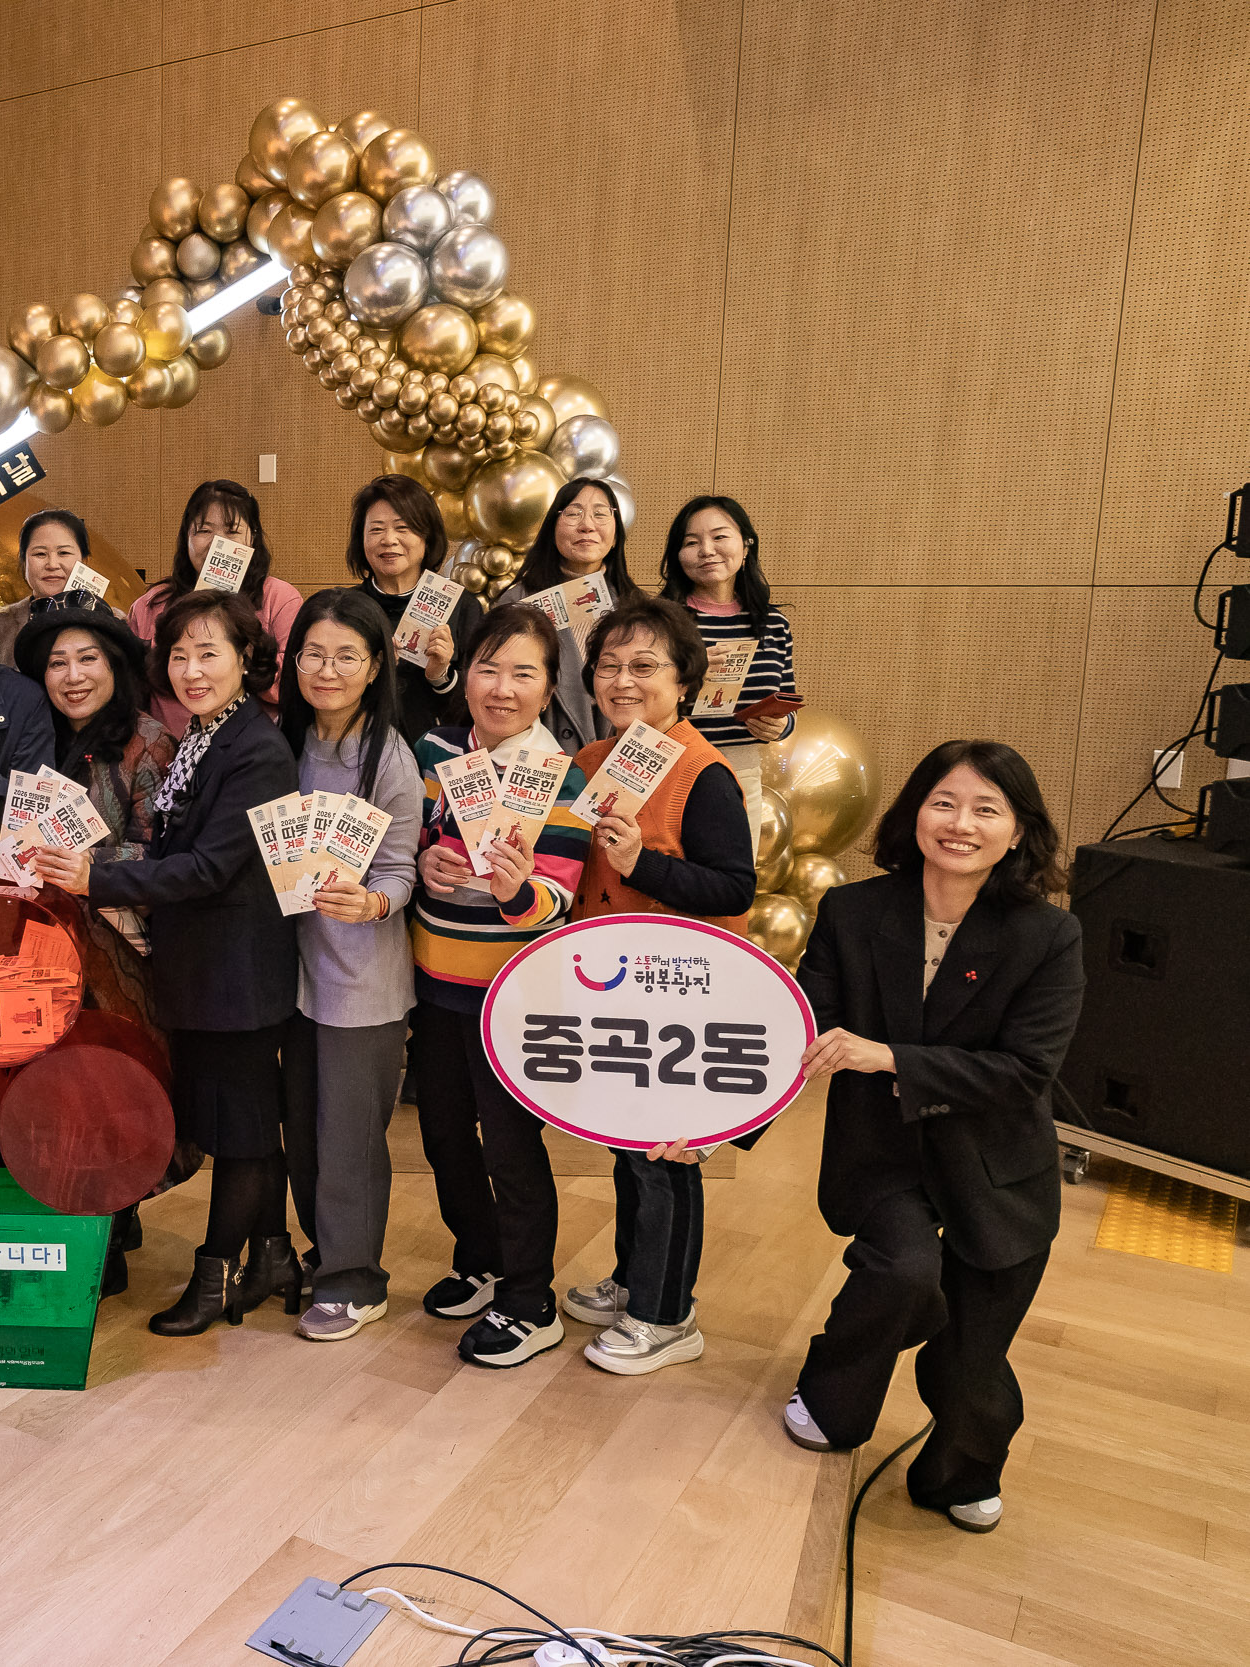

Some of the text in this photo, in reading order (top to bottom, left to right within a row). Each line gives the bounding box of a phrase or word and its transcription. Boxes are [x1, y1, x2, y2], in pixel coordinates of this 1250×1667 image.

[2, 452, 36, 487] 날
[210, 556, 241, 574] 따뜻한
[417, 591, 449, 612] 따뜻한
[620, 743, 662, 775] 따뜻한
[450, 776, 493, 800] 따뜻한
[509, 771, 555, 793] 따뜻한
[11, 796, 50, 814] 따뜻한
[56, 806, 86, 846] 따뜻한
[336, 819, 375, 848] 따뜻한
[634, 955, 710, 971] 소통하며 발전하는
[634, 969, 710, 995] 행복광진
[522, 1014, 770, 1095] 중곡2동
